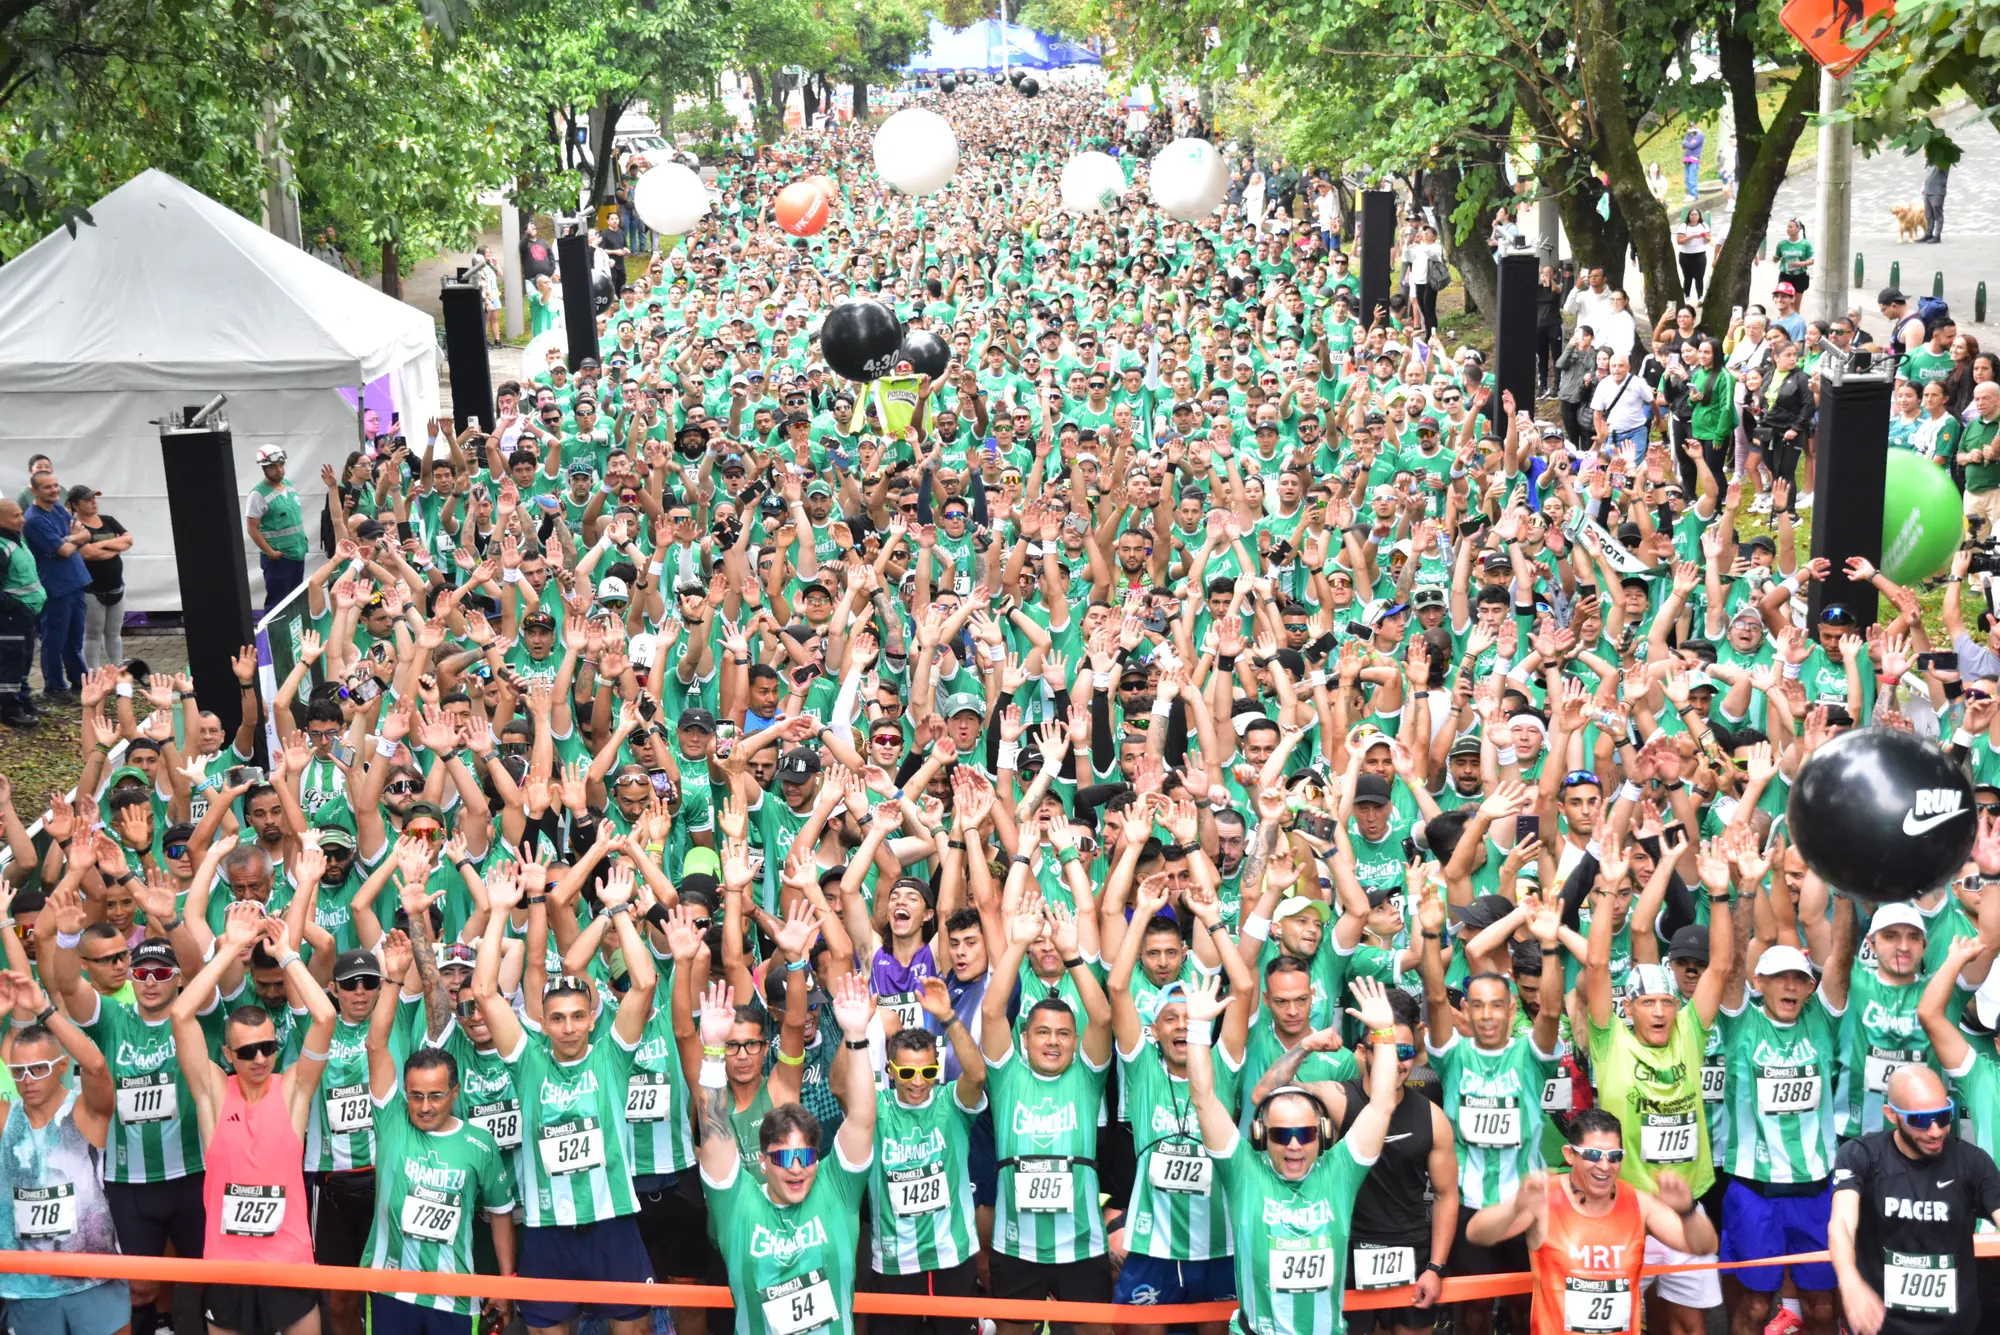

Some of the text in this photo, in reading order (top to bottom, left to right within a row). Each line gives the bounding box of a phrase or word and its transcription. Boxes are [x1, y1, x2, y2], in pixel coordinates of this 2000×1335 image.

[863, 350, 899, 372] 4:30
[1915, 789, 1962, 816] RUN
[140, 945, 166, 955] KRONOS
[133, 1088, 162, 1112] 1111
[627, 1088, 657, 1112] 213
[1771, 1080, 1814, 1102] 1388
[1473, 1113, 1511, 1136] 1105
[558, 1135, 591, 1163] 524
[1658, 1129, 1691, 1151] 1115
[1163, 1158, 1204, 1183] 1312
[901, 1178, 941, 1206] 1428
[1028, 1176, 1063, 1200] 895
[30, 1202, 61, 1227] 718
[233, 1201, 278, 1225] 1257
[411, 1203, 456, 1232] 1786
[1884, 1196, 1949, 1222] PACER
[1282, 1254, 1327, 1280] 3451
[1371, 1250, 1404, 1276] 1121
[1569, 1244, 1626, 1269] MRT
[1899, 1272, 1948, 1298] 1905
[791, 1291, 815, 1323] 54
[1587, 1297, 1614, 1321] 25
